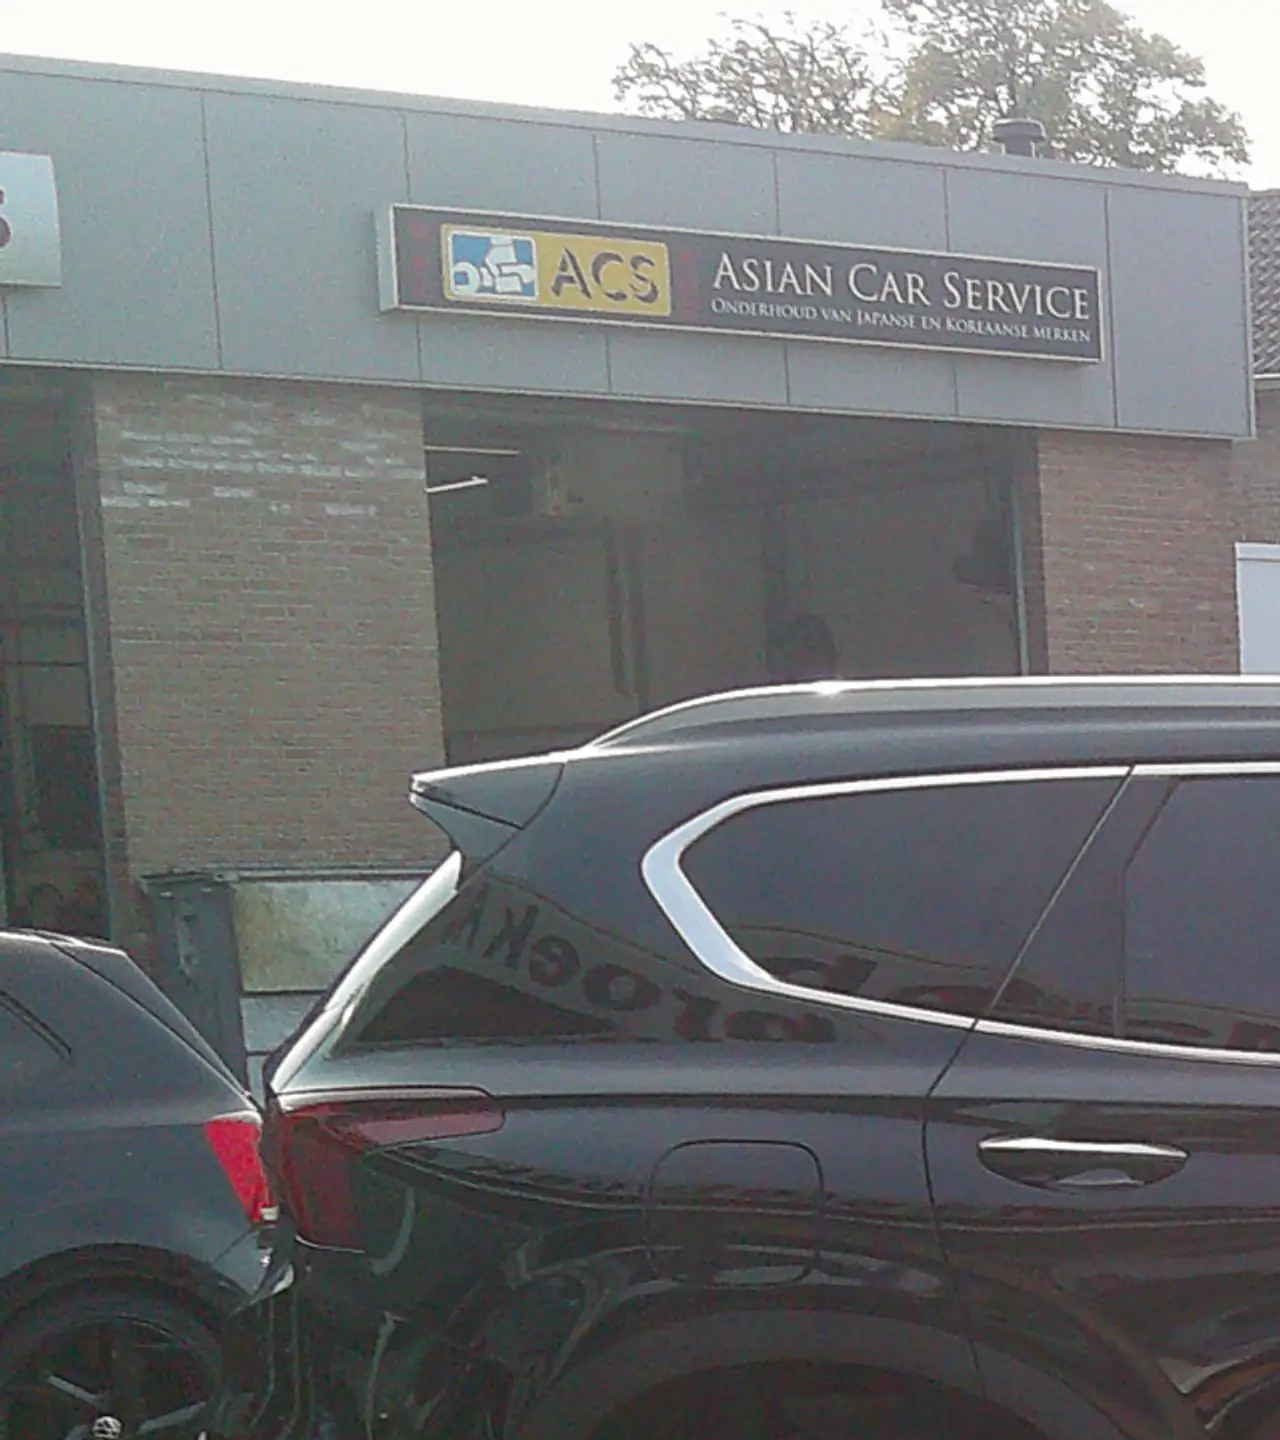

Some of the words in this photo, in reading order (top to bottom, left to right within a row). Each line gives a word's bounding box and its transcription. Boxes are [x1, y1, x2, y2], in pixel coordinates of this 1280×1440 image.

[550, 247, 660, 304] ACS
[713, 251, 833, 297] ASIAN
[848, 262, 932, 307] CAR
[943, 271, 1090, 321] SERVICE
